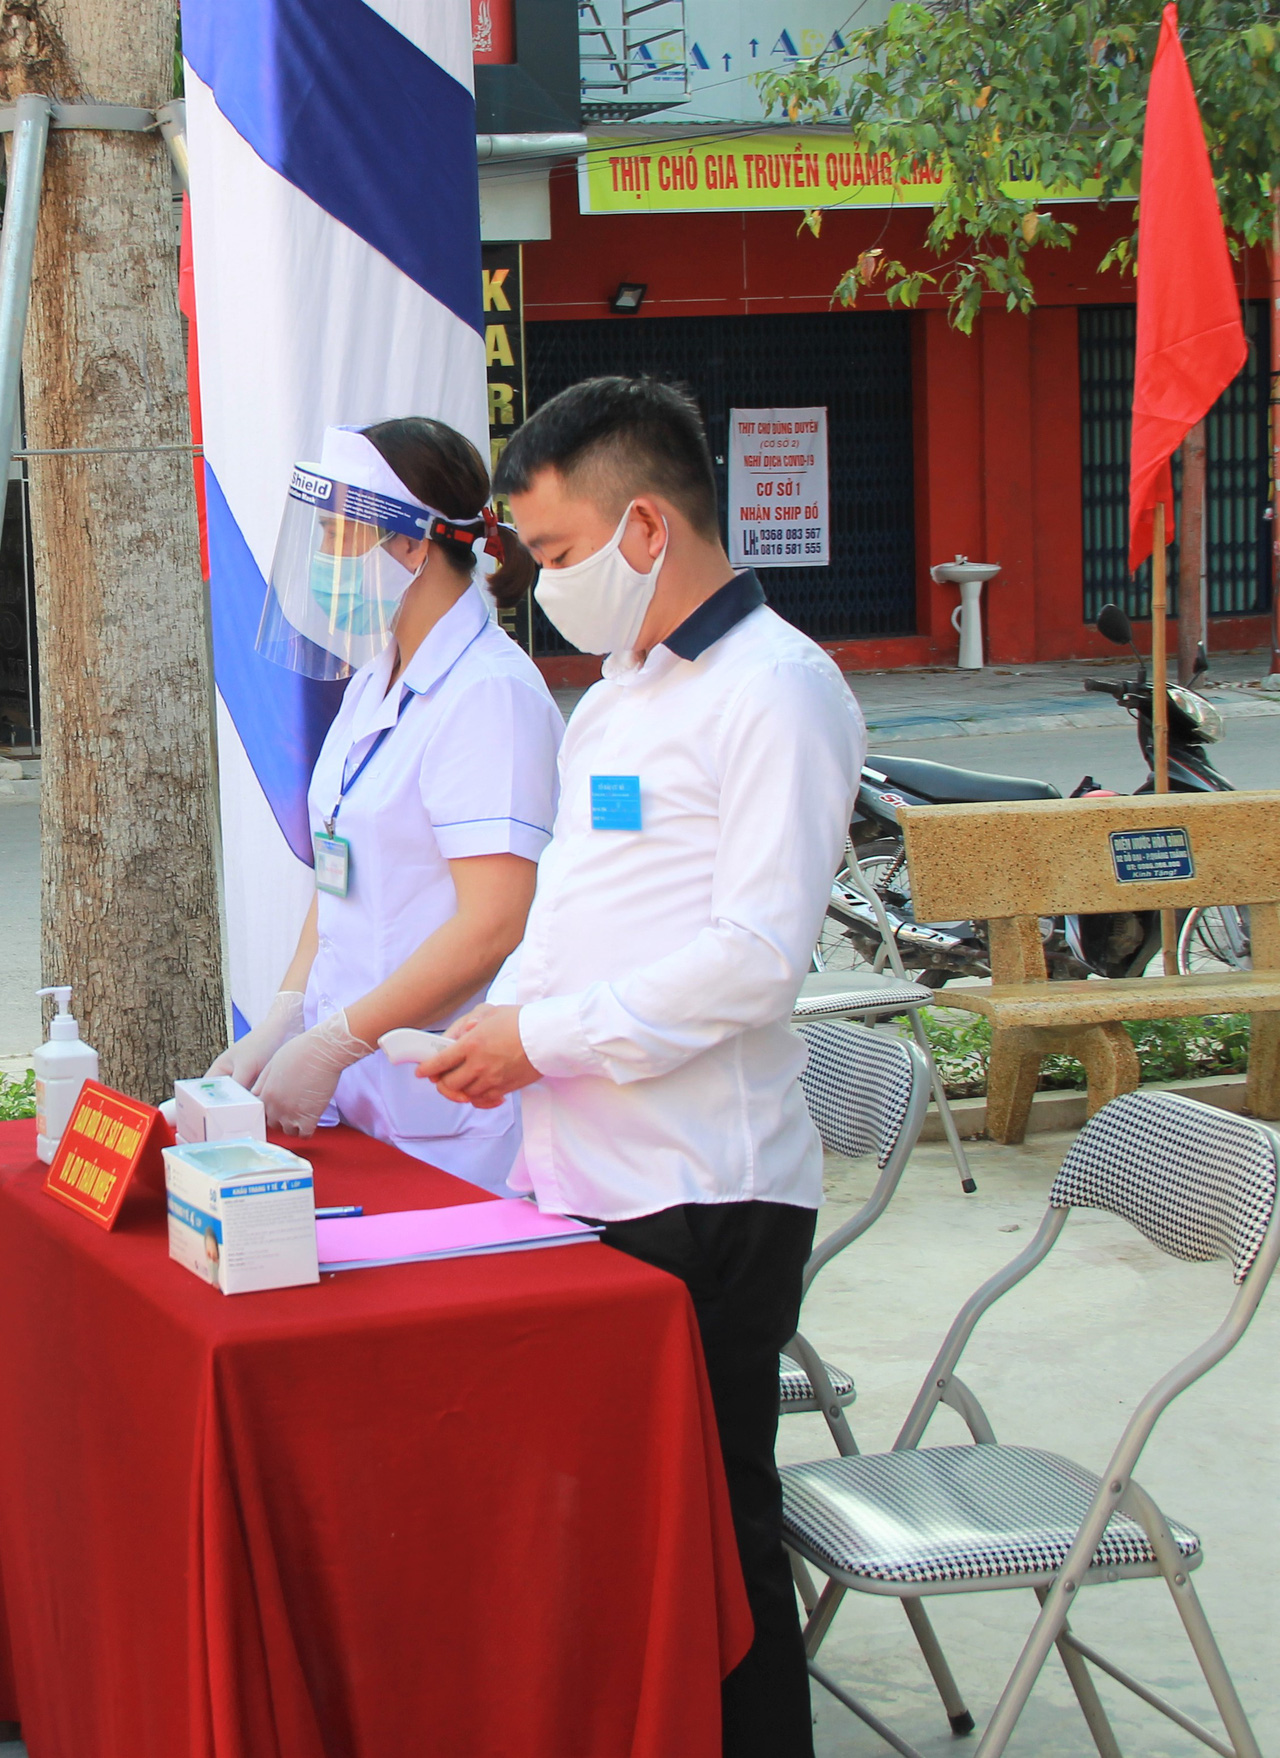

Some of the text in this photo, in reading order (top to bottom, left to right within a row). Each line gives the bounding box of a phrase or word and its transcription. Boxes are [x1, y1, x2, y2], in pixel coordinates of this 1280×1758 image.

[609, 156, 651, 199] THỊT
[658, 147, 698, 191] CHÓ
[704, 154, 739, 190] GIA
[825, 141, 893, 191] QUẢNG
[738, 422, 755, 436] THỊT
[791, 440, 800, 448] 2)
[783, 454, 814, 467] COVID-19
[291, 471, 330, 496] Shield
[757, 478, 801, 496] CƠ SỞ 1
[740, 504, 770, 524] NHẬN
[774, 506, 801, 520] SHIP
[760, 528, 821, 541] 0368 083 567
[761, 543, 821, 555] 0816 581 555
